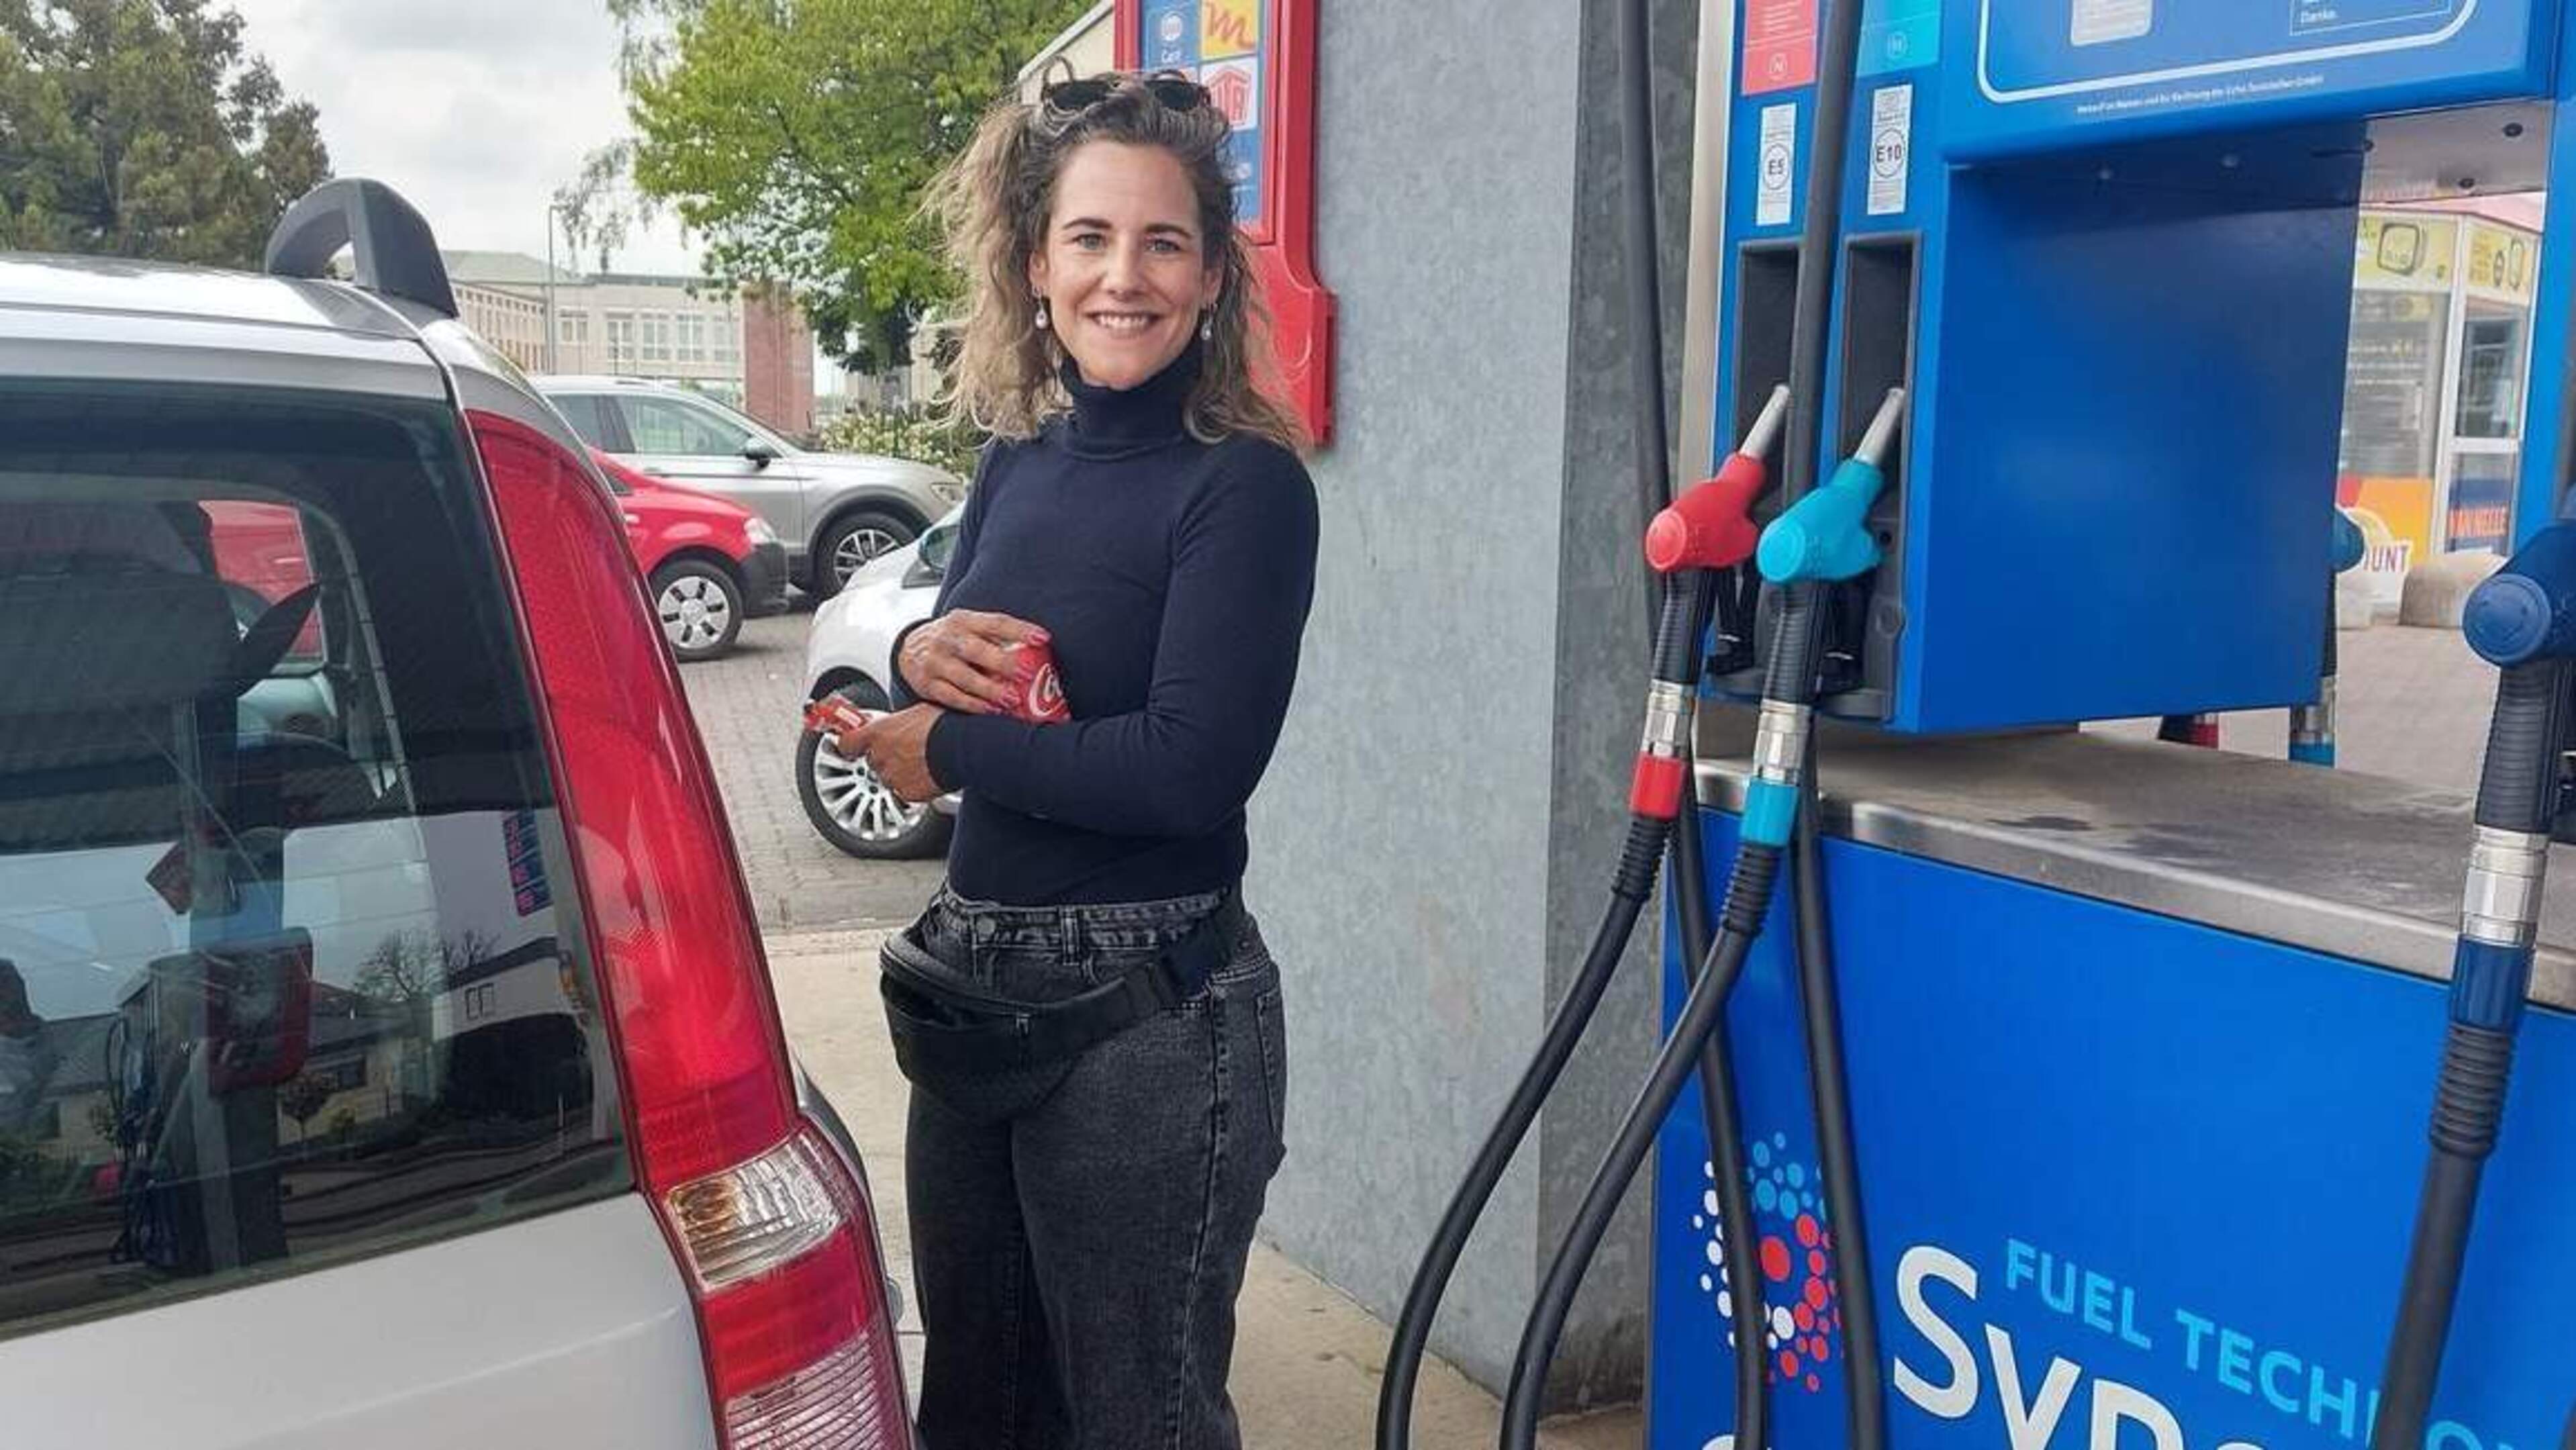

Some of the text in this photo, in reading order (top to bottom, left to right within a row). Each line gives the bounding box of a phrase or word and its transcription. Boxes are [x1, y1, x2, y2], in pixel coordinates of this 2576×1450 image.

[1876, 144, 1903, 164] E10
[1768, 158, 1785, 175] E5
[2364, 544, 2410, 572] UNT
[2006, 1238, 2151, 1349] FUEL
